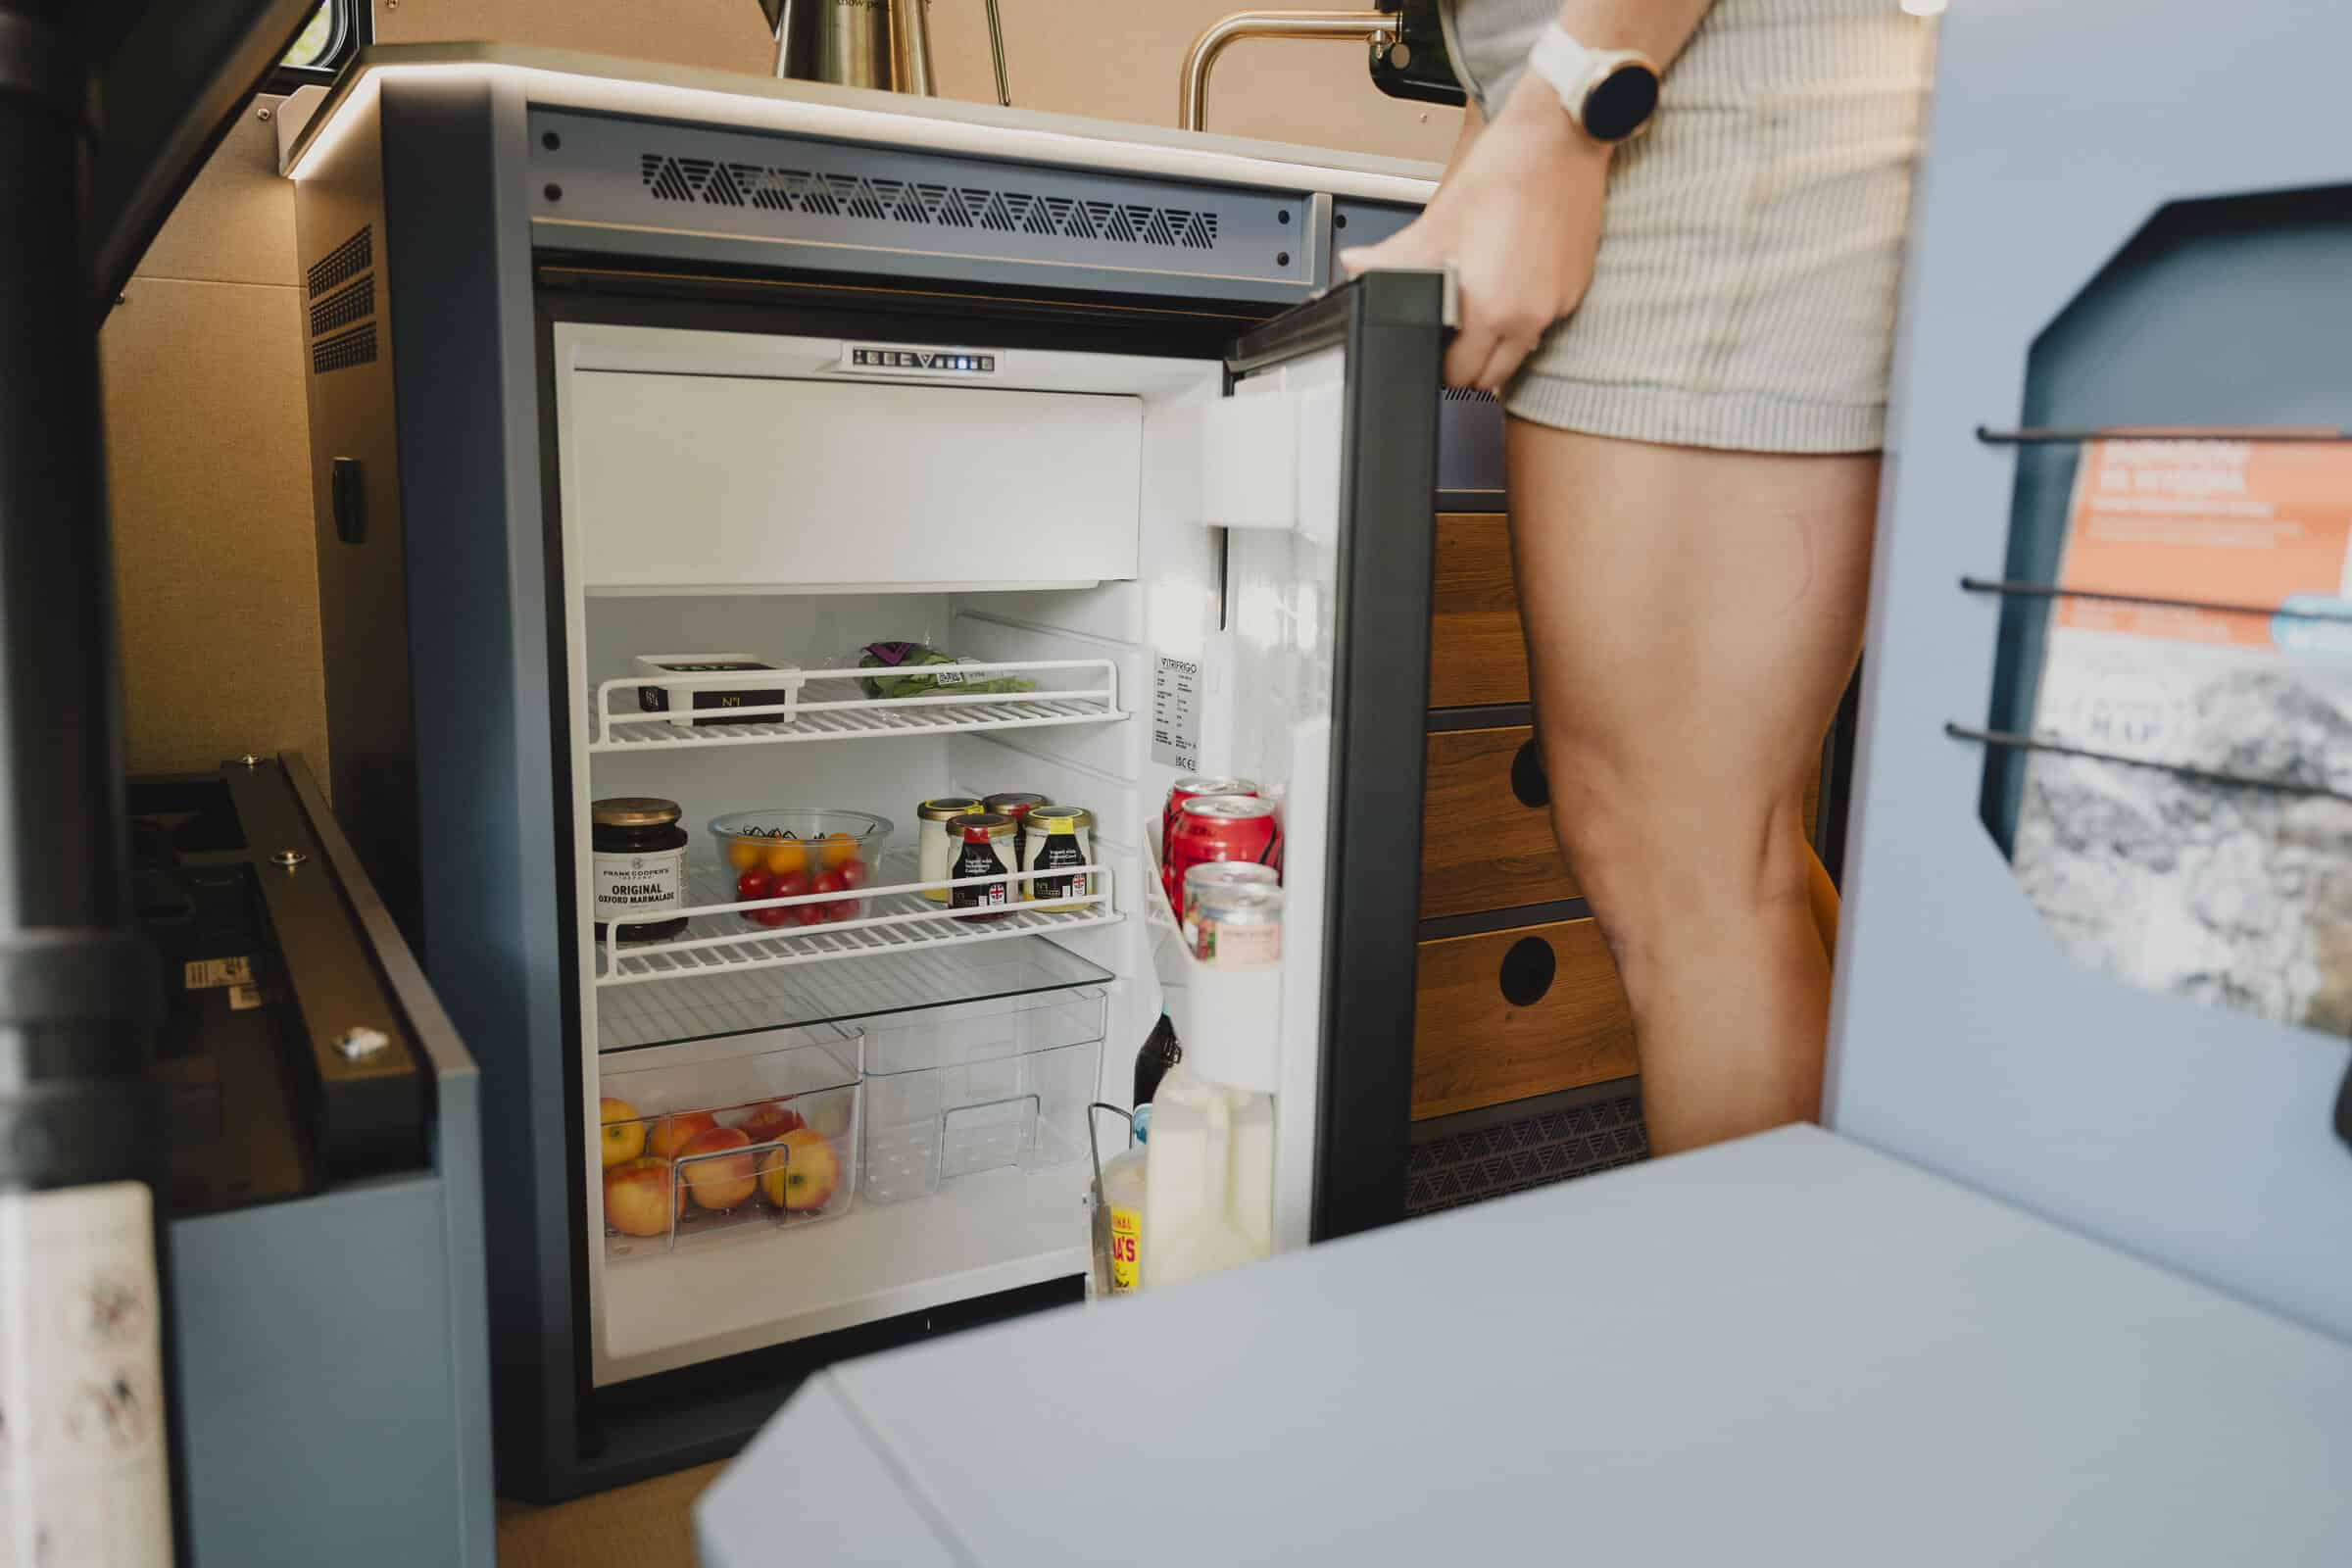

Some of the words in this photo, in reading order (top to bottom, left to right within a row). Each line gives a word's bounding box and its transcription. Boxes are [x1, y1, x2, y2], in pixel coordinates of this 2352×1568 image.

[631, 868, 669, 877] COOPER'S
[612, 883, 662, 896] ORIGINAL
[598, 894, 628, 904] OXFORD
[629, 892, 675, 904] MARMALADE
